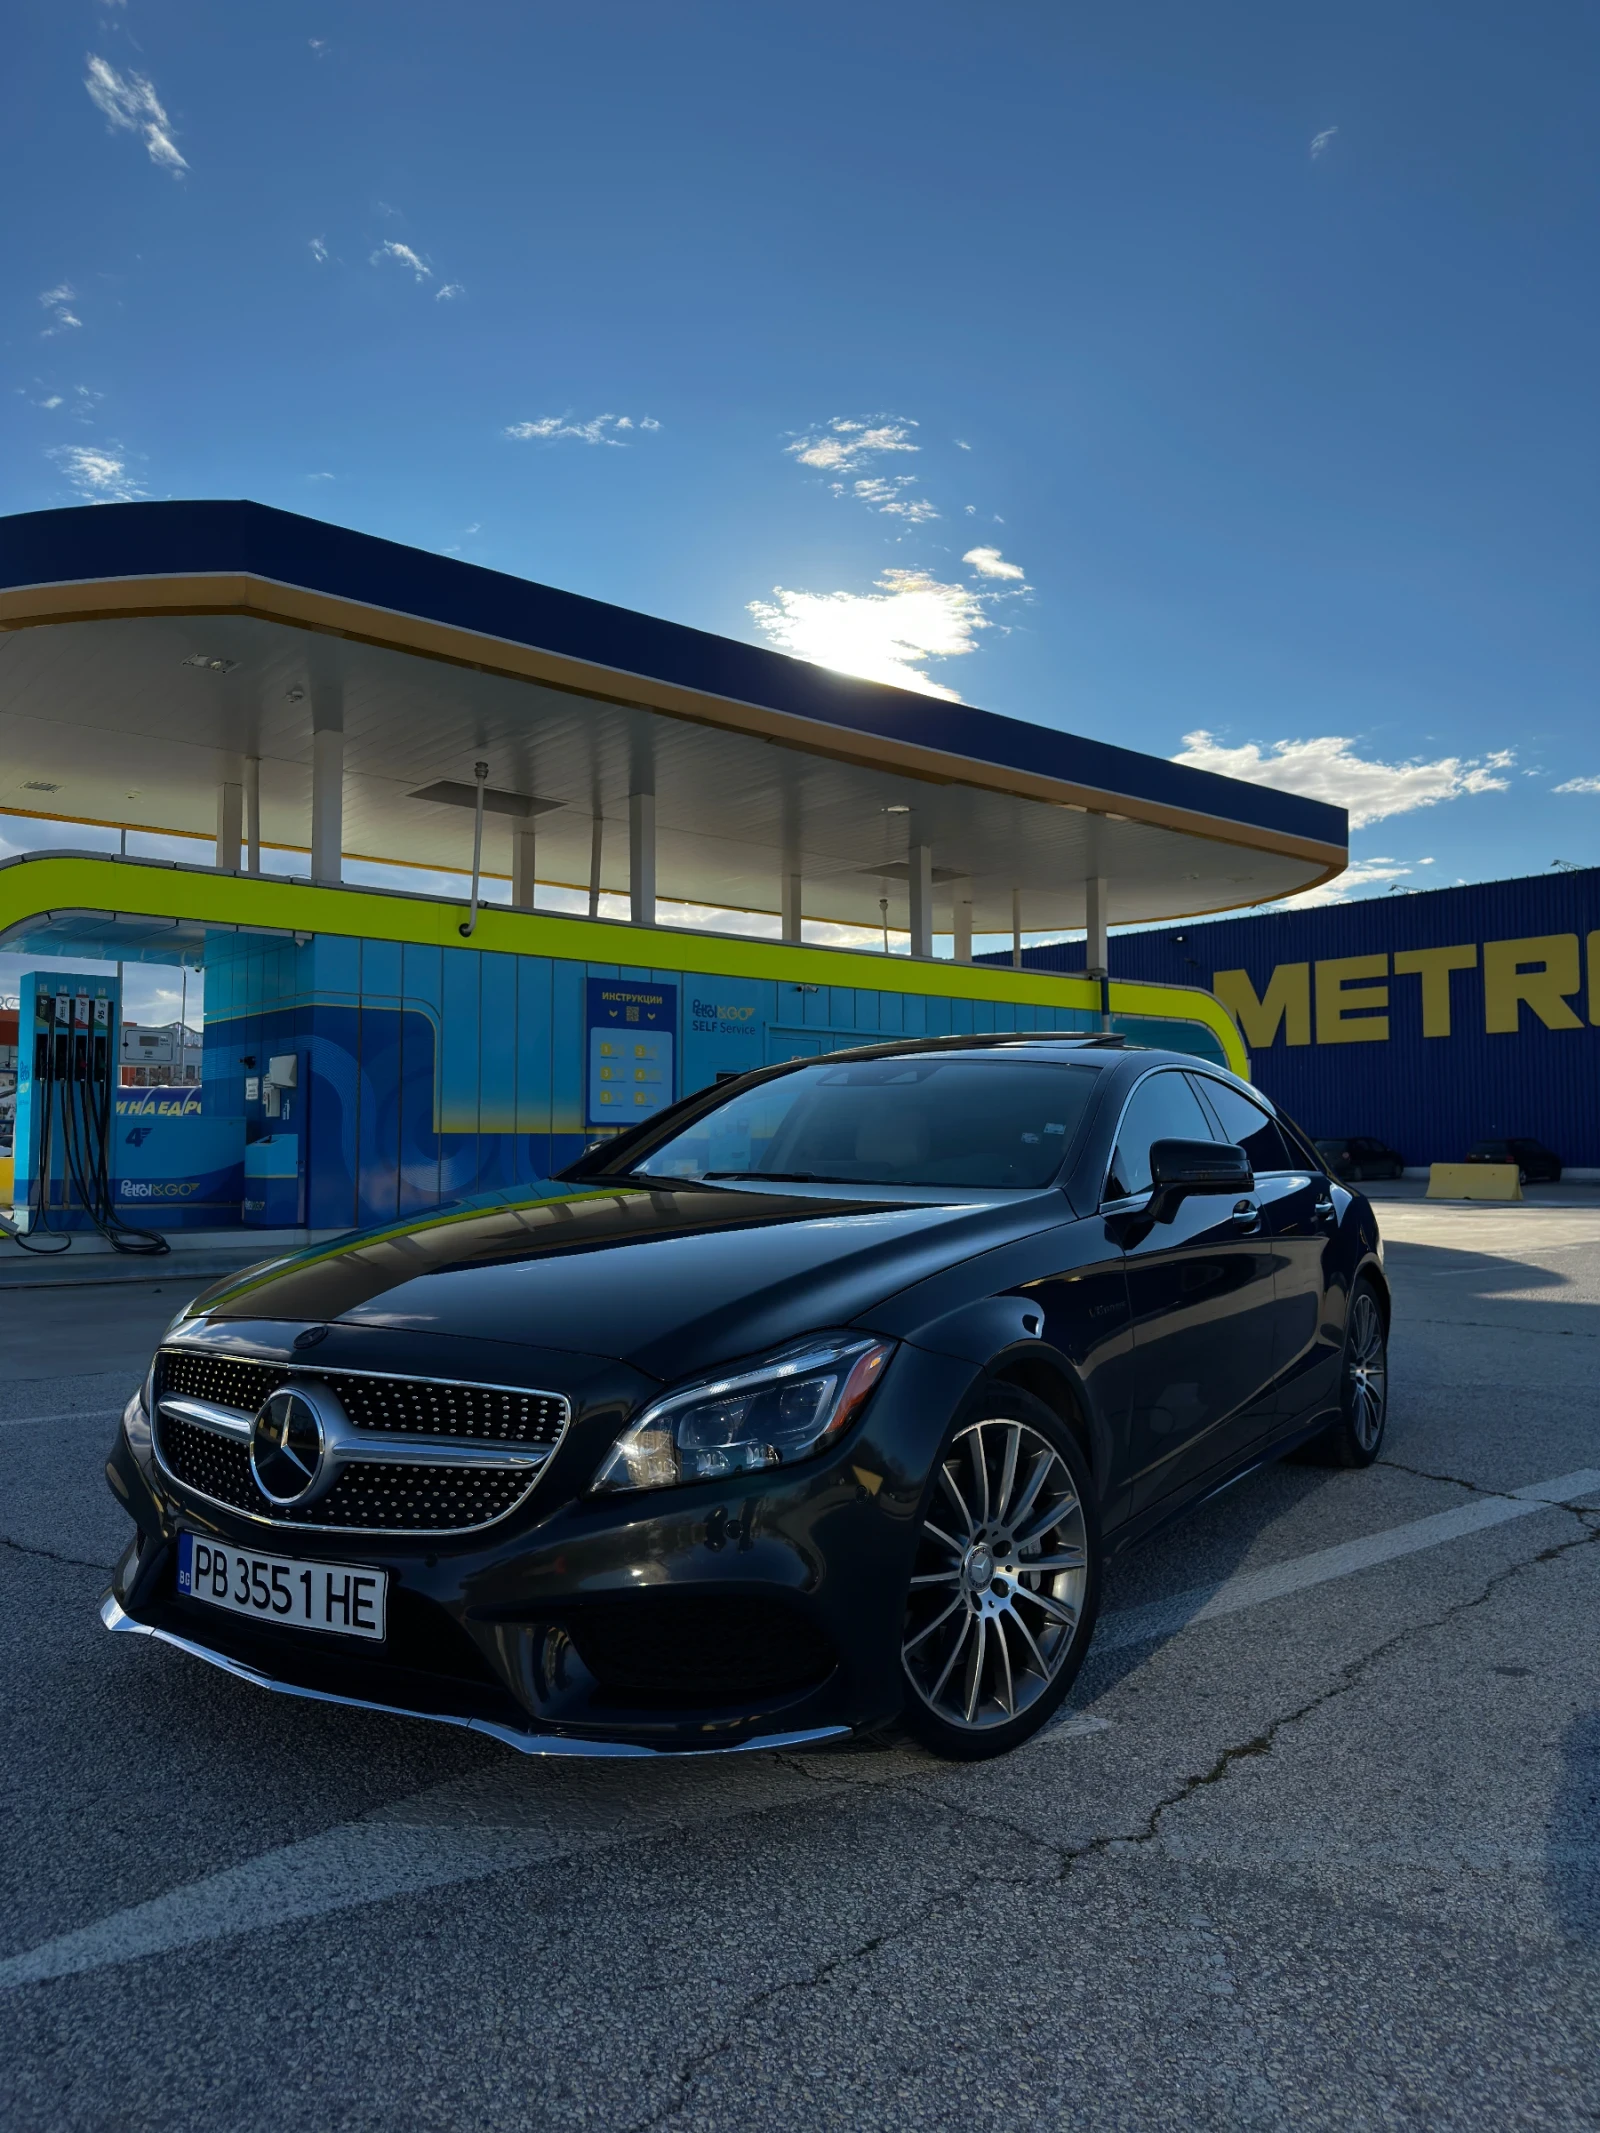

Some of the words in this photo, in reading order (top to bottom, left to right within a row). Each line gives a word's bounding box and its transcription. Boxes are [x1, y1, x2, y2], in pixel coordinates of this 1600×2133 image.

[1213, 929, 1600, 1049] METR
[601, 991, 663, 1005] ИНСТРУКЦИИ
[692, 1019, 718, 1033] SELF
[719, 1021, 756, 1036] Service
[178, 1569, 191, 1587] BG
